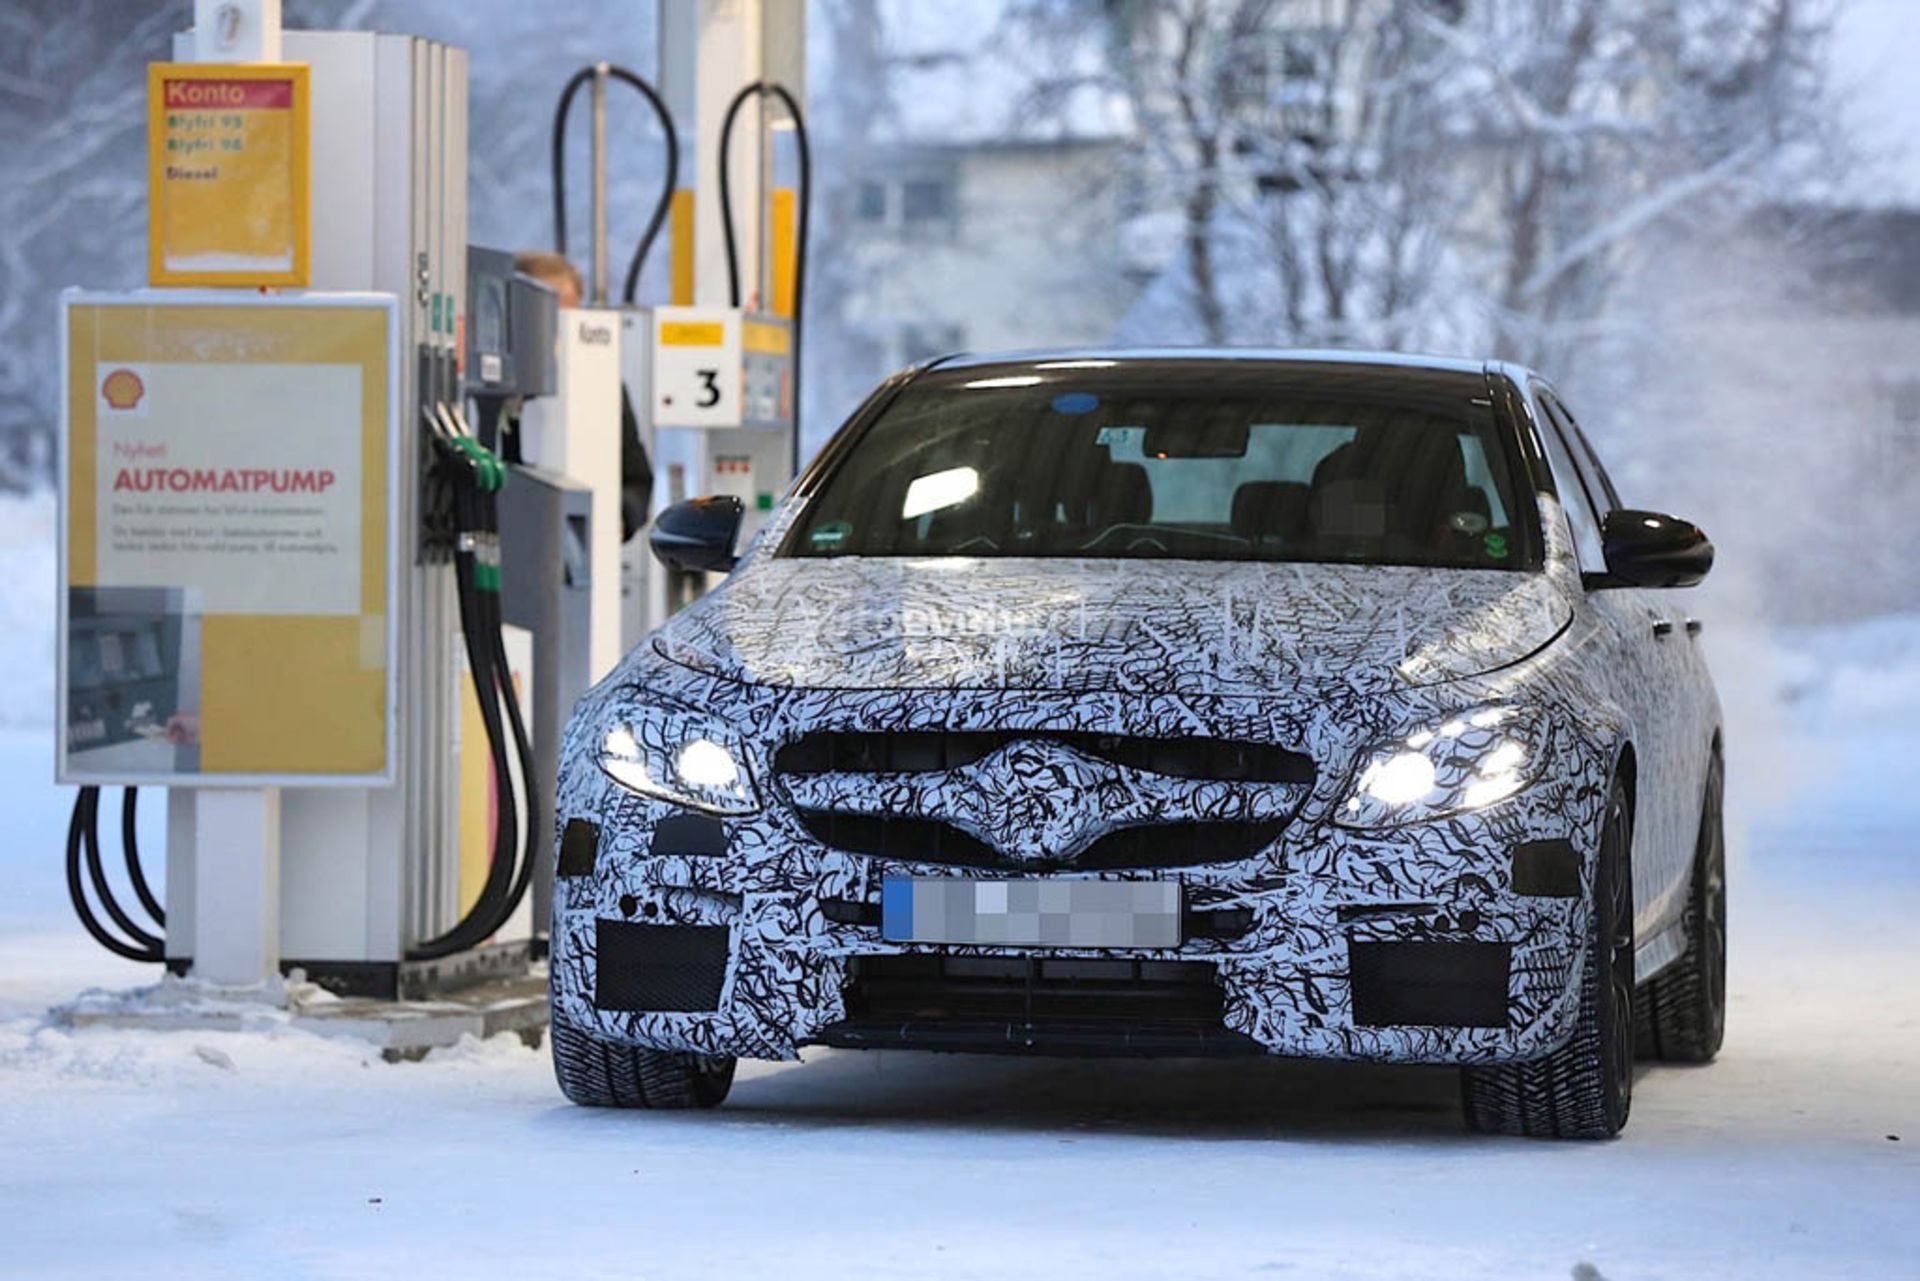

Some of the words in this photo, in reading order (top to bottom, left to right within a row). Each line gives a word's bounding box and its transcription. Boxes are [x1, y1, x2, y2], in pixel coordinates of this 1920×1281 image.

[167, 82, 246, 102] Konto
[165, 166, 219, 180] Diesel
[695, 369, 721, 408] 3
[113, 467, 336, 493] AUTOMATPUMP
